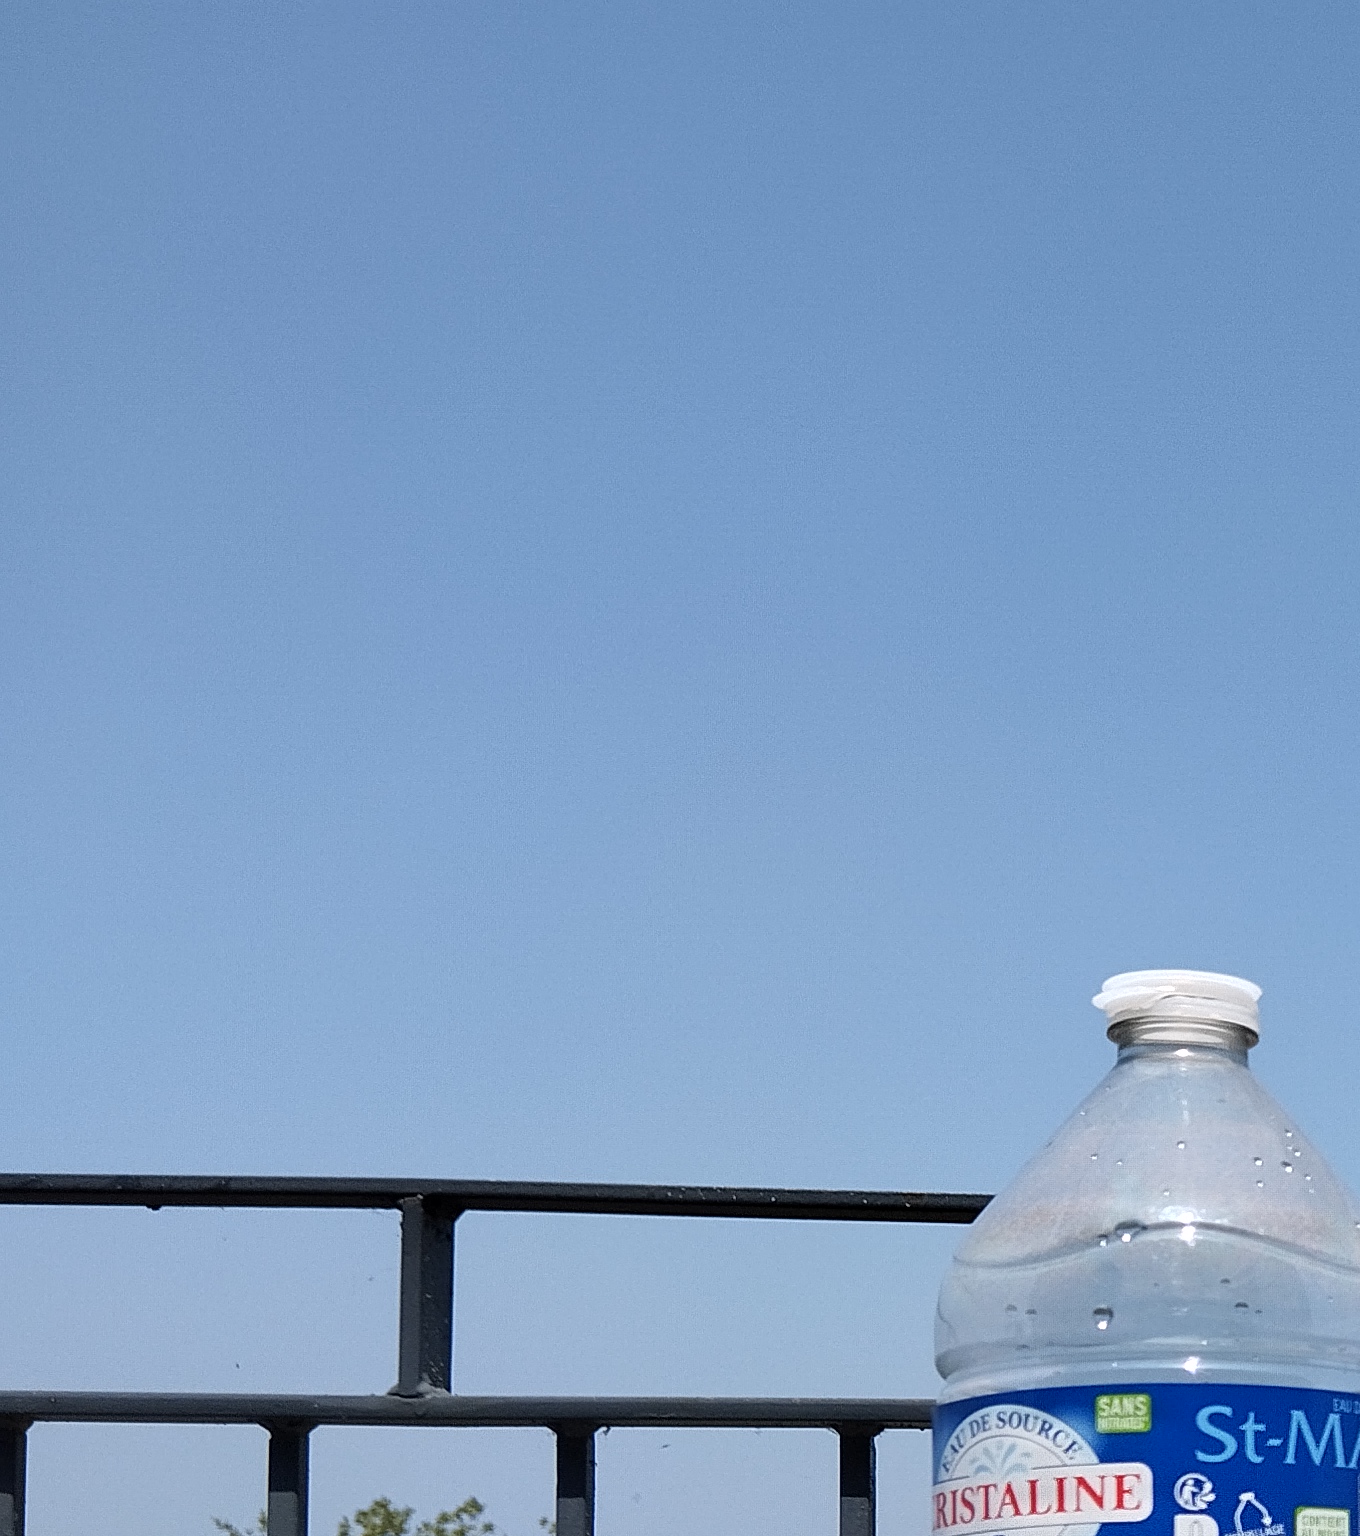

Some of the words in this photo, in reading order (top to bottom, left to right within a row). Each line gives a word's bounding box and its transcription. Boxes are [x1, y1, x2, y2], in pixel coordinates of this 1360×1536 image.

[1098, 1396, 1147, 1416] SANS
[968, 1413, 992, 1439] DE
[996, 1410, 1085, 1460] SOURCE
